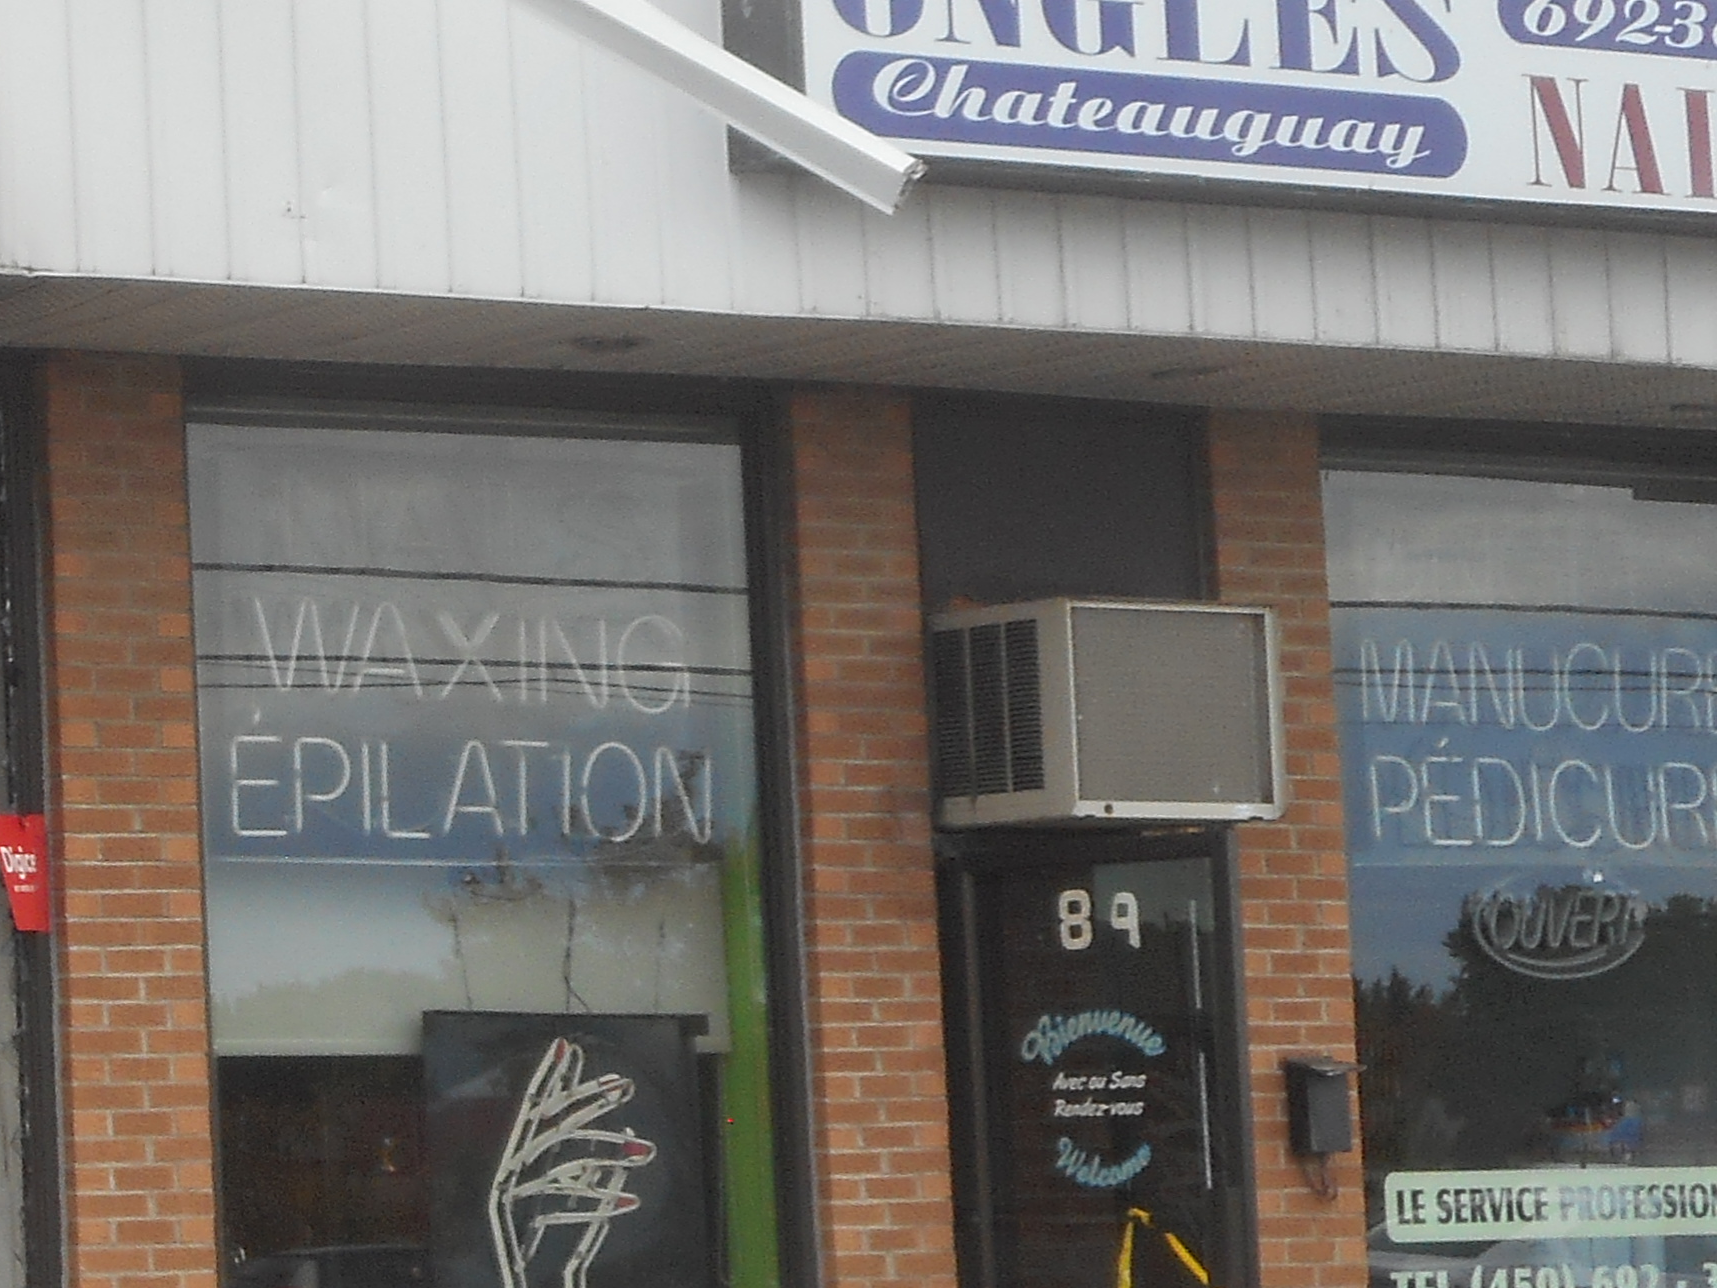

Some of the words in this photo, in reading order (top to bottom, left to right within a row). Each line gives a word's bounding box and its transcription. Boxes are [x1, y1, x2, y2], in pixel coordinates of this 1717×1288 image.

[870, 57, 1431, 168] Chateauguay
[255, 599, 691, 714] WAXING
[231, 708, 712, 843] ÉPILATION
[1371, 737, 1717, 849] PÉDICUR
[1059, 890, 1141, 950] 89
[1395, 1189, 1426, 1225] LE
[1436, 1187, 1549, 1224] SERVICE
